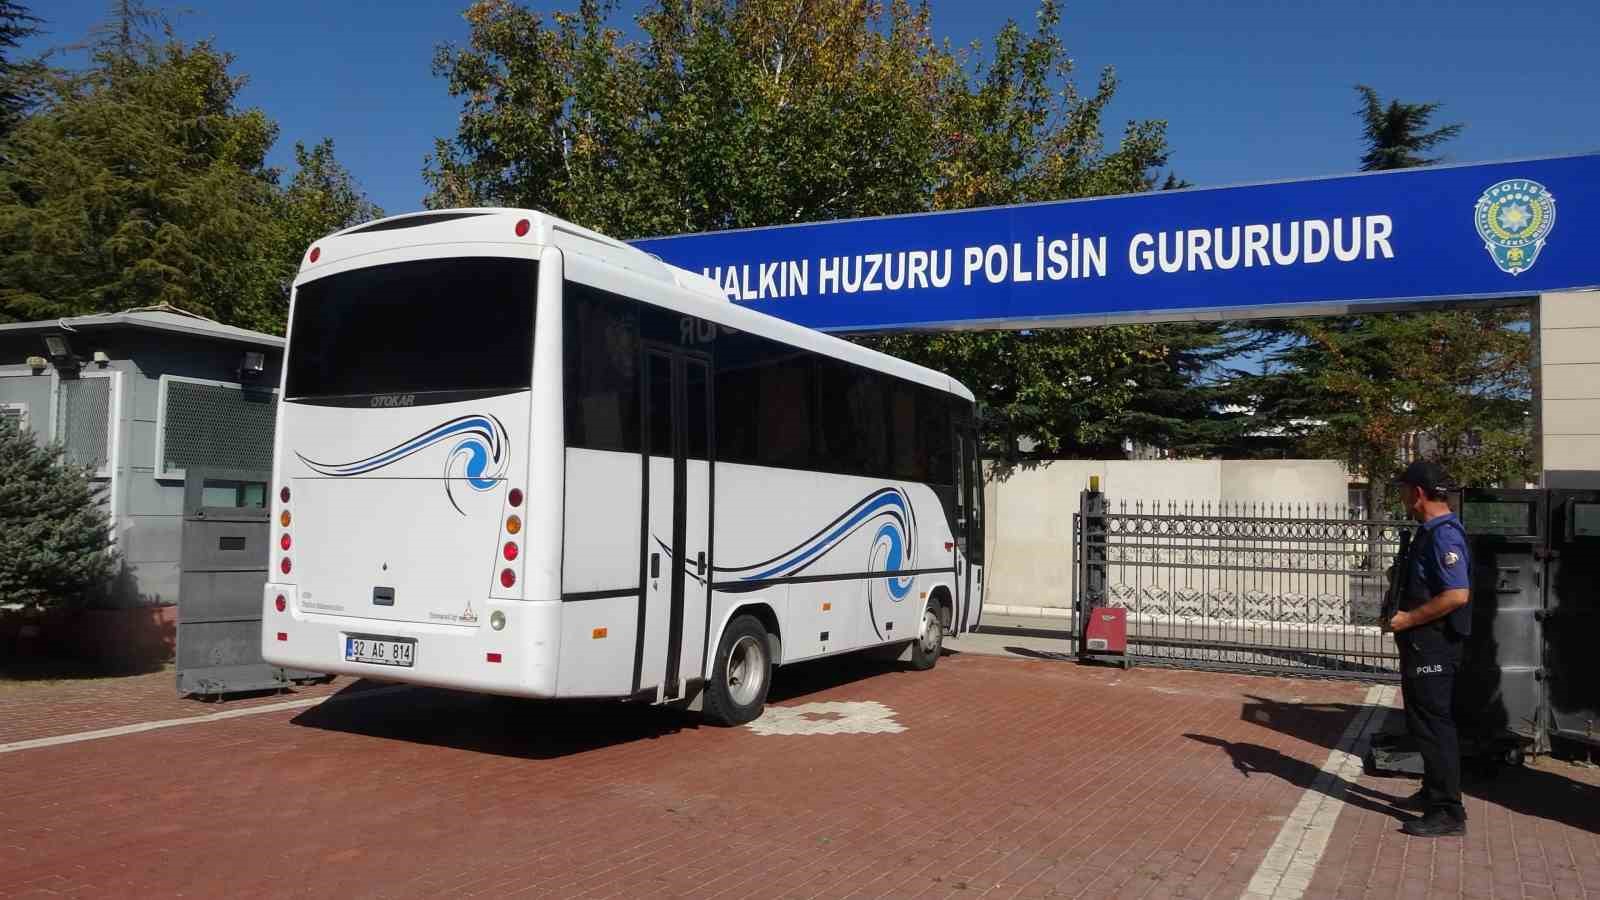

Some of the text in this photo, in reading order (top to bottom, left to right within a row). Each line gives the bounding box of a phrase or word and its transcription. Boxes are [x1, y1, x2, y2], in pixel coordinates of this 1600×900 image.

[818, 246, 953, 296] HUZURU
[962, 232, 1108, 286] POLİSİN
[1128, 214, 1394, 276] GURURUDUR
[370, 395, 416, 407] OTOKAR
[353, 641, 410, 660] 32 AG 814
